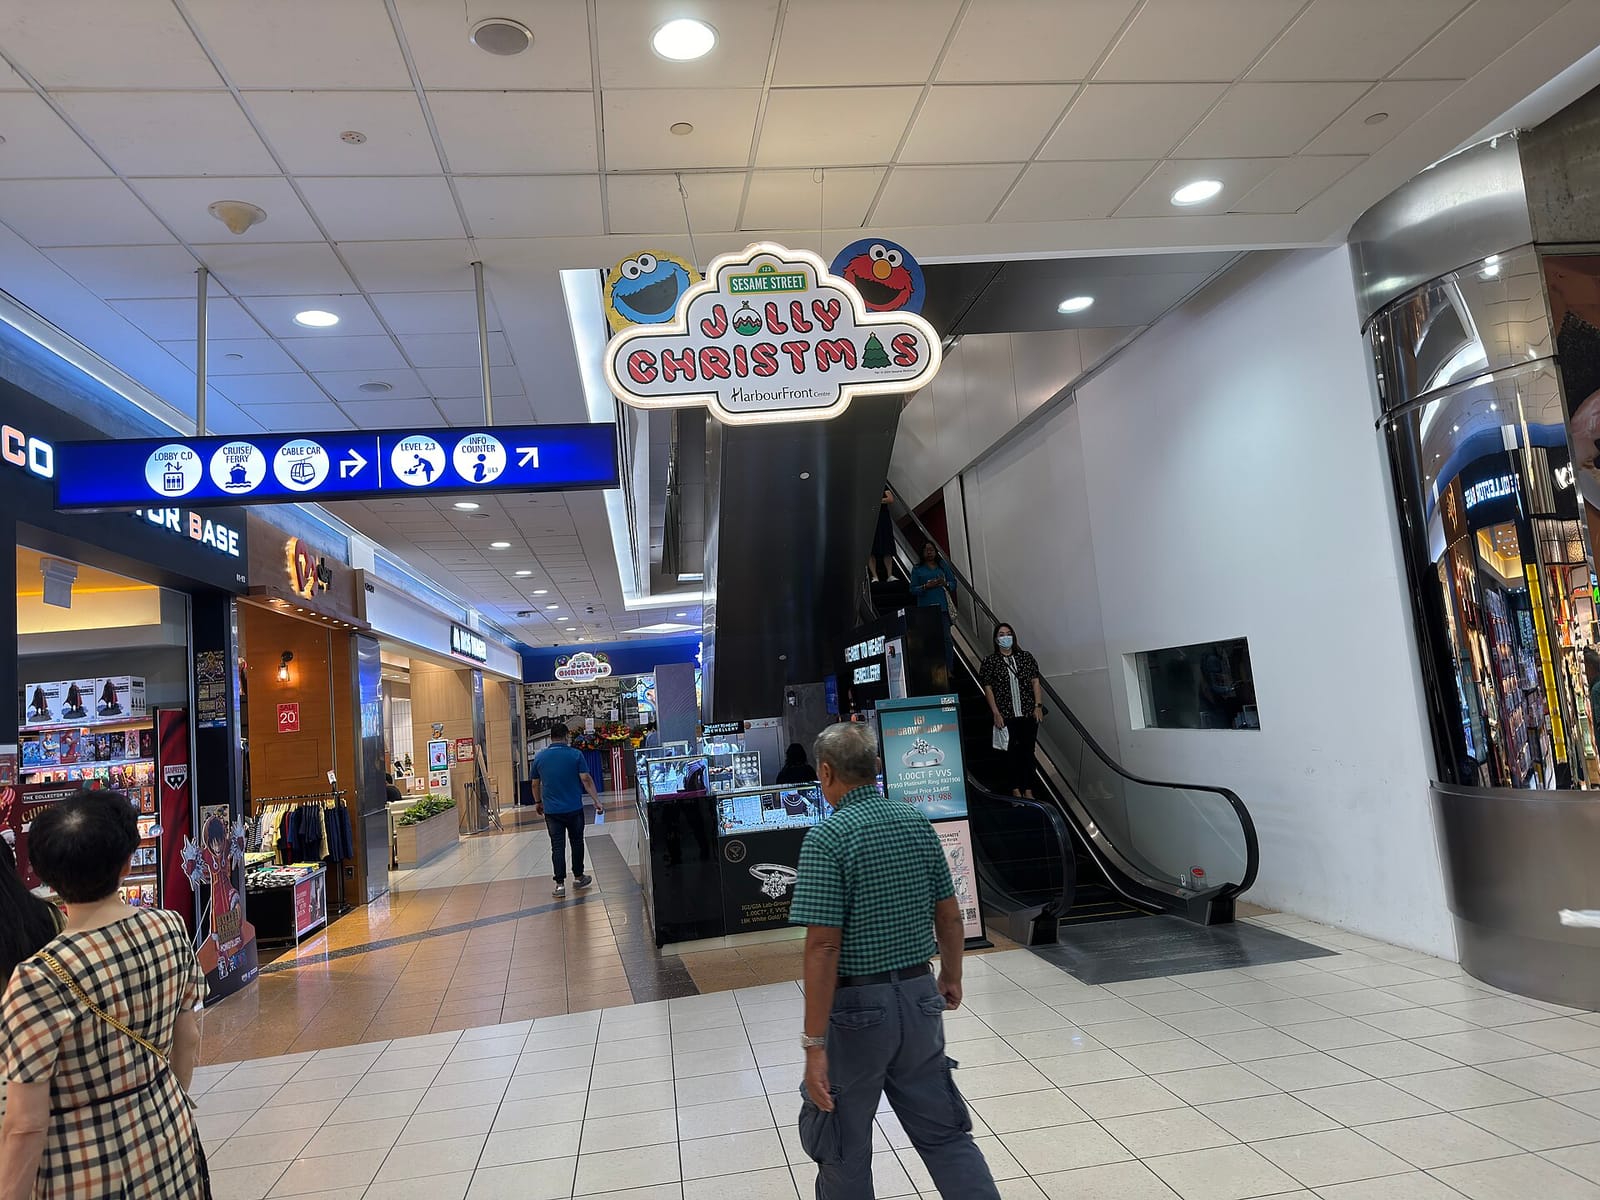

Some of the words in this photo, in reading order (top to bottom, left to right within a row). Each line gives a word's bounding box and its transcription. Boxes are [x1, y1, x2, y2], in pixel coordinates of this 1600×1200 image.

[732, 277, 768, 291] SESAME
[770, 275, 804, 289] STREET
[700, 298, 841, 339] JOLLY
[627, 332, 918, 384] CHRISTMAS
[730, 386, 813, 402] HarbourFront
[469, 437, 487, 445] INFO
[281, 447, 304, 456] CABLE
[306, 446, 321, 455] CAR
[401, 443, 422, 451] LEVEL
[461, 445, 496, 453] COUNTER
[154, 452, 179, 461] LOBBY
[226, 455, 249, 463] FERRY
[189, 511, 239, 556] BASE
[280, 711, 295, 724] 20
[935, 768, 952, 777] VVS
